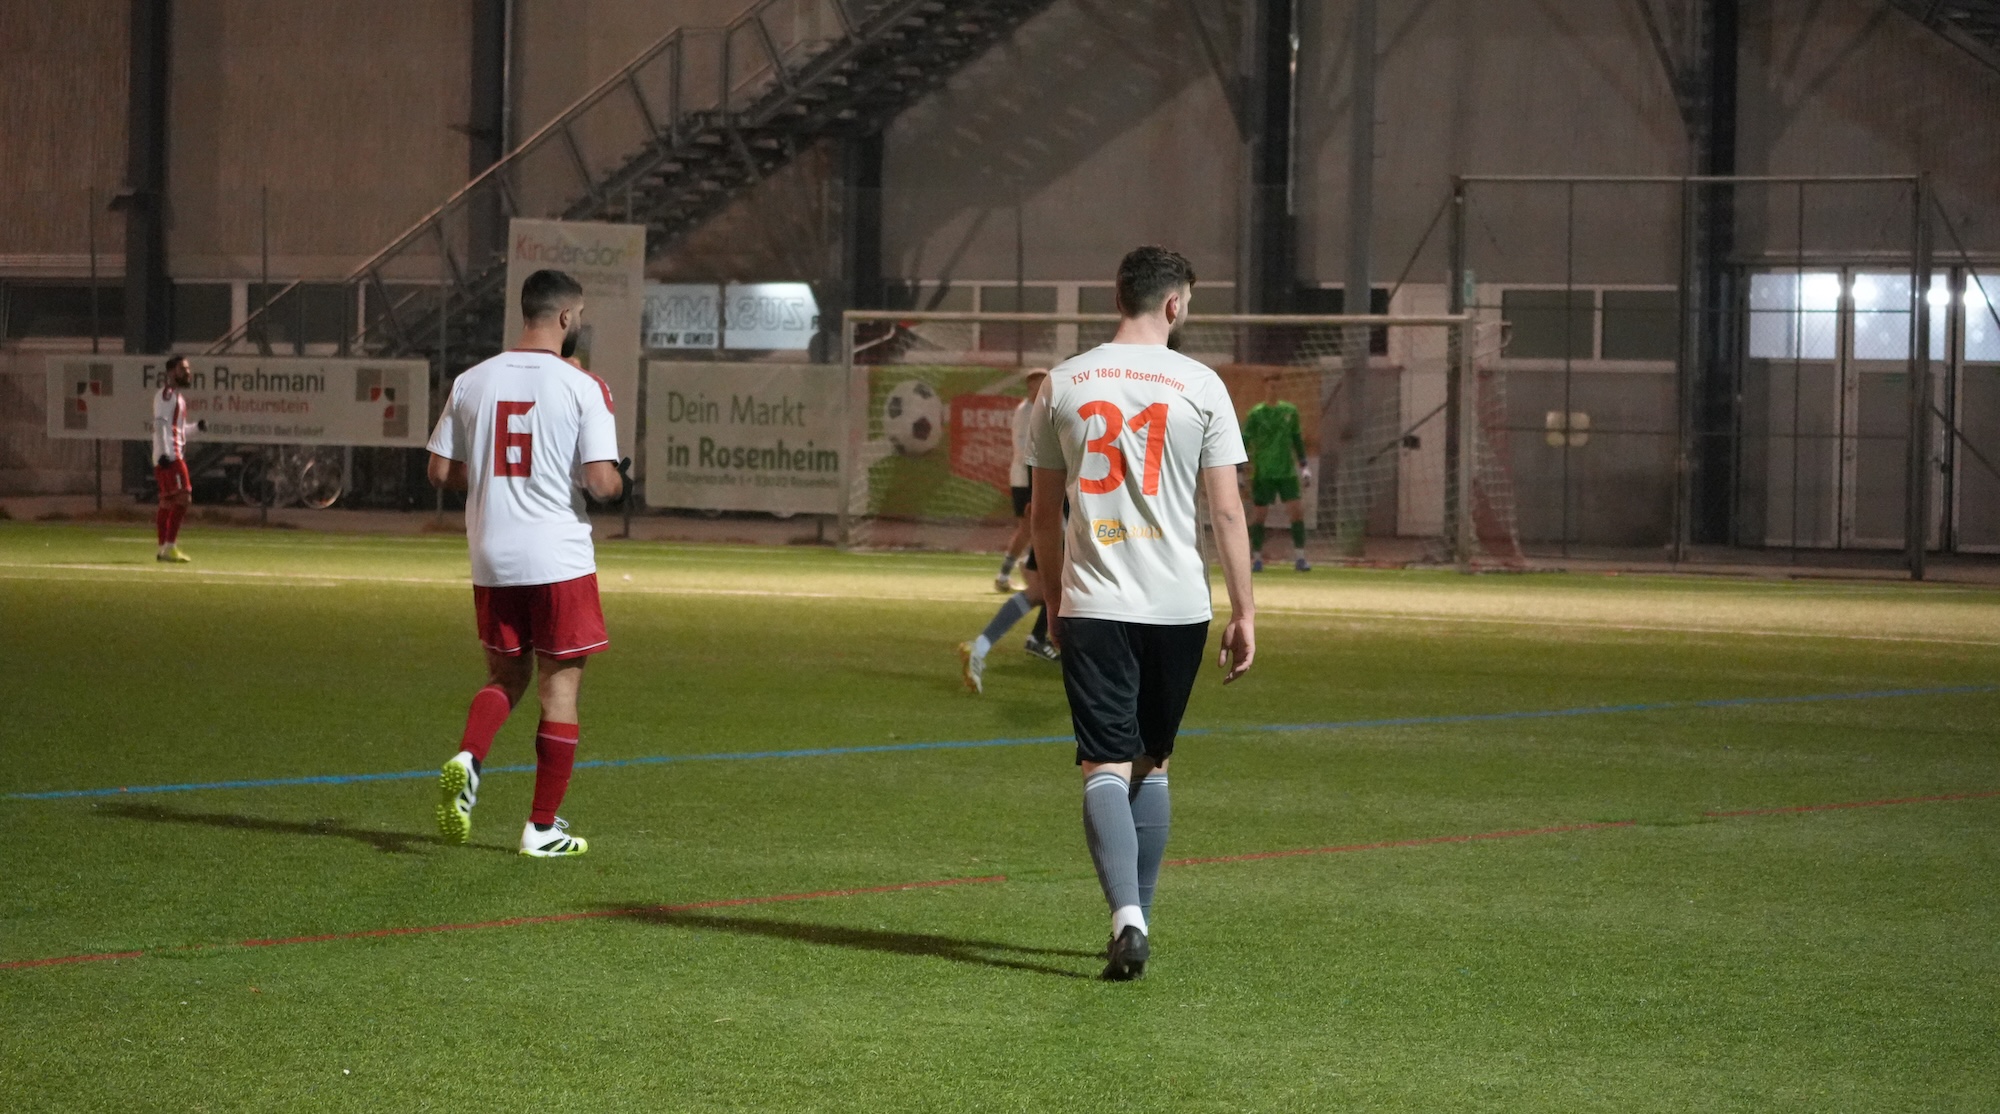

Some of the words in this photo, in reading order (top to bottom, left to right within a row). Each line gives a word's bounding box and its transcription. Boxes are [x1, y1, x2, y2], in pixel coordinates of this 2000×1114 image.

[1072, 370, 1091, 386] TSV
[1095, 367, 1121, 379] 1860
[1125, 368, 1185, 392] Rosenheim
[667, 390, 719, 425] Dein
[729, 393, 806, 428] Markt
[493, 400, 536, 477] 6
[666, 436, 690, 467] in
[699, 436, 839, 473] Rosenheim
[1077, 400, 1169, 496] 31
